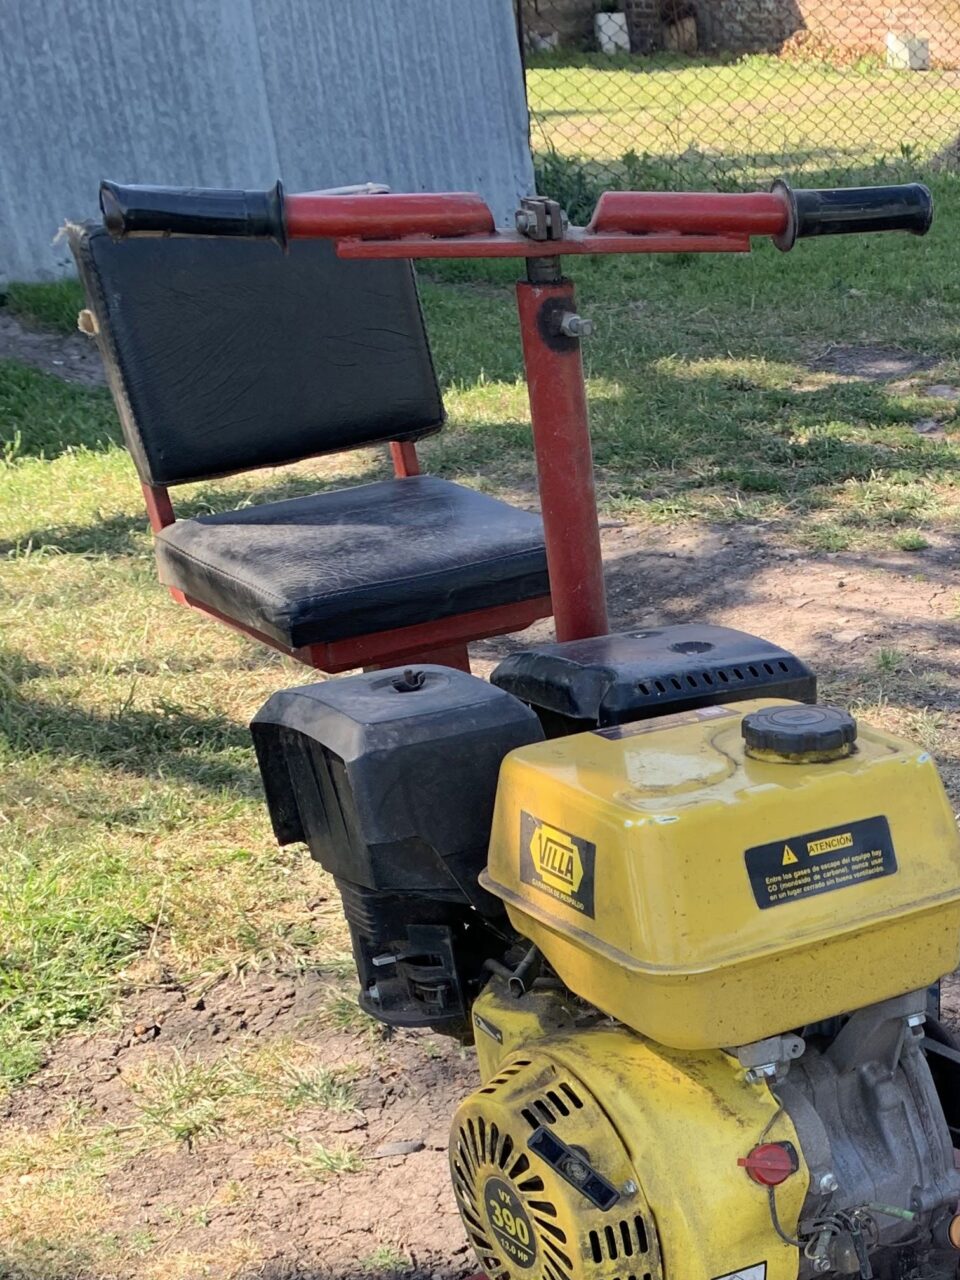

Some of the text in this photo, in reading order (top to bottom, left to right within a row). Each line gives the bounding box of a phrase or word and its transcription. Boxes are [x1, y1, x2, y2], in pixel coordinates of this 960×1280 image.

[538, 833, 574, 880] VILLA
[809, 835, 852, 853] ATENCIÓN
[765, 876, 782, 885] Entre
[793, 868, 811, 878] gases
[811, 865, 820, 873] de
[820, 860, 841, 870] escape
[841, 856, 850, 865] del
[851, 852, 871, 863] equipo
[871, 849, 882, 857] hay
[767, 884, 778, 893] CO
[851, 861, 869, 871] nunca
[870, 857, 883, 866] usar
[787, 887, 803, 897] lugar
[803, 881, 826, 892] cerrado
[826, 878, 835, 886] sin
[489, 1199, 530, 1246] 390
[501, 1238, 528, 1262] 13.0 HP
